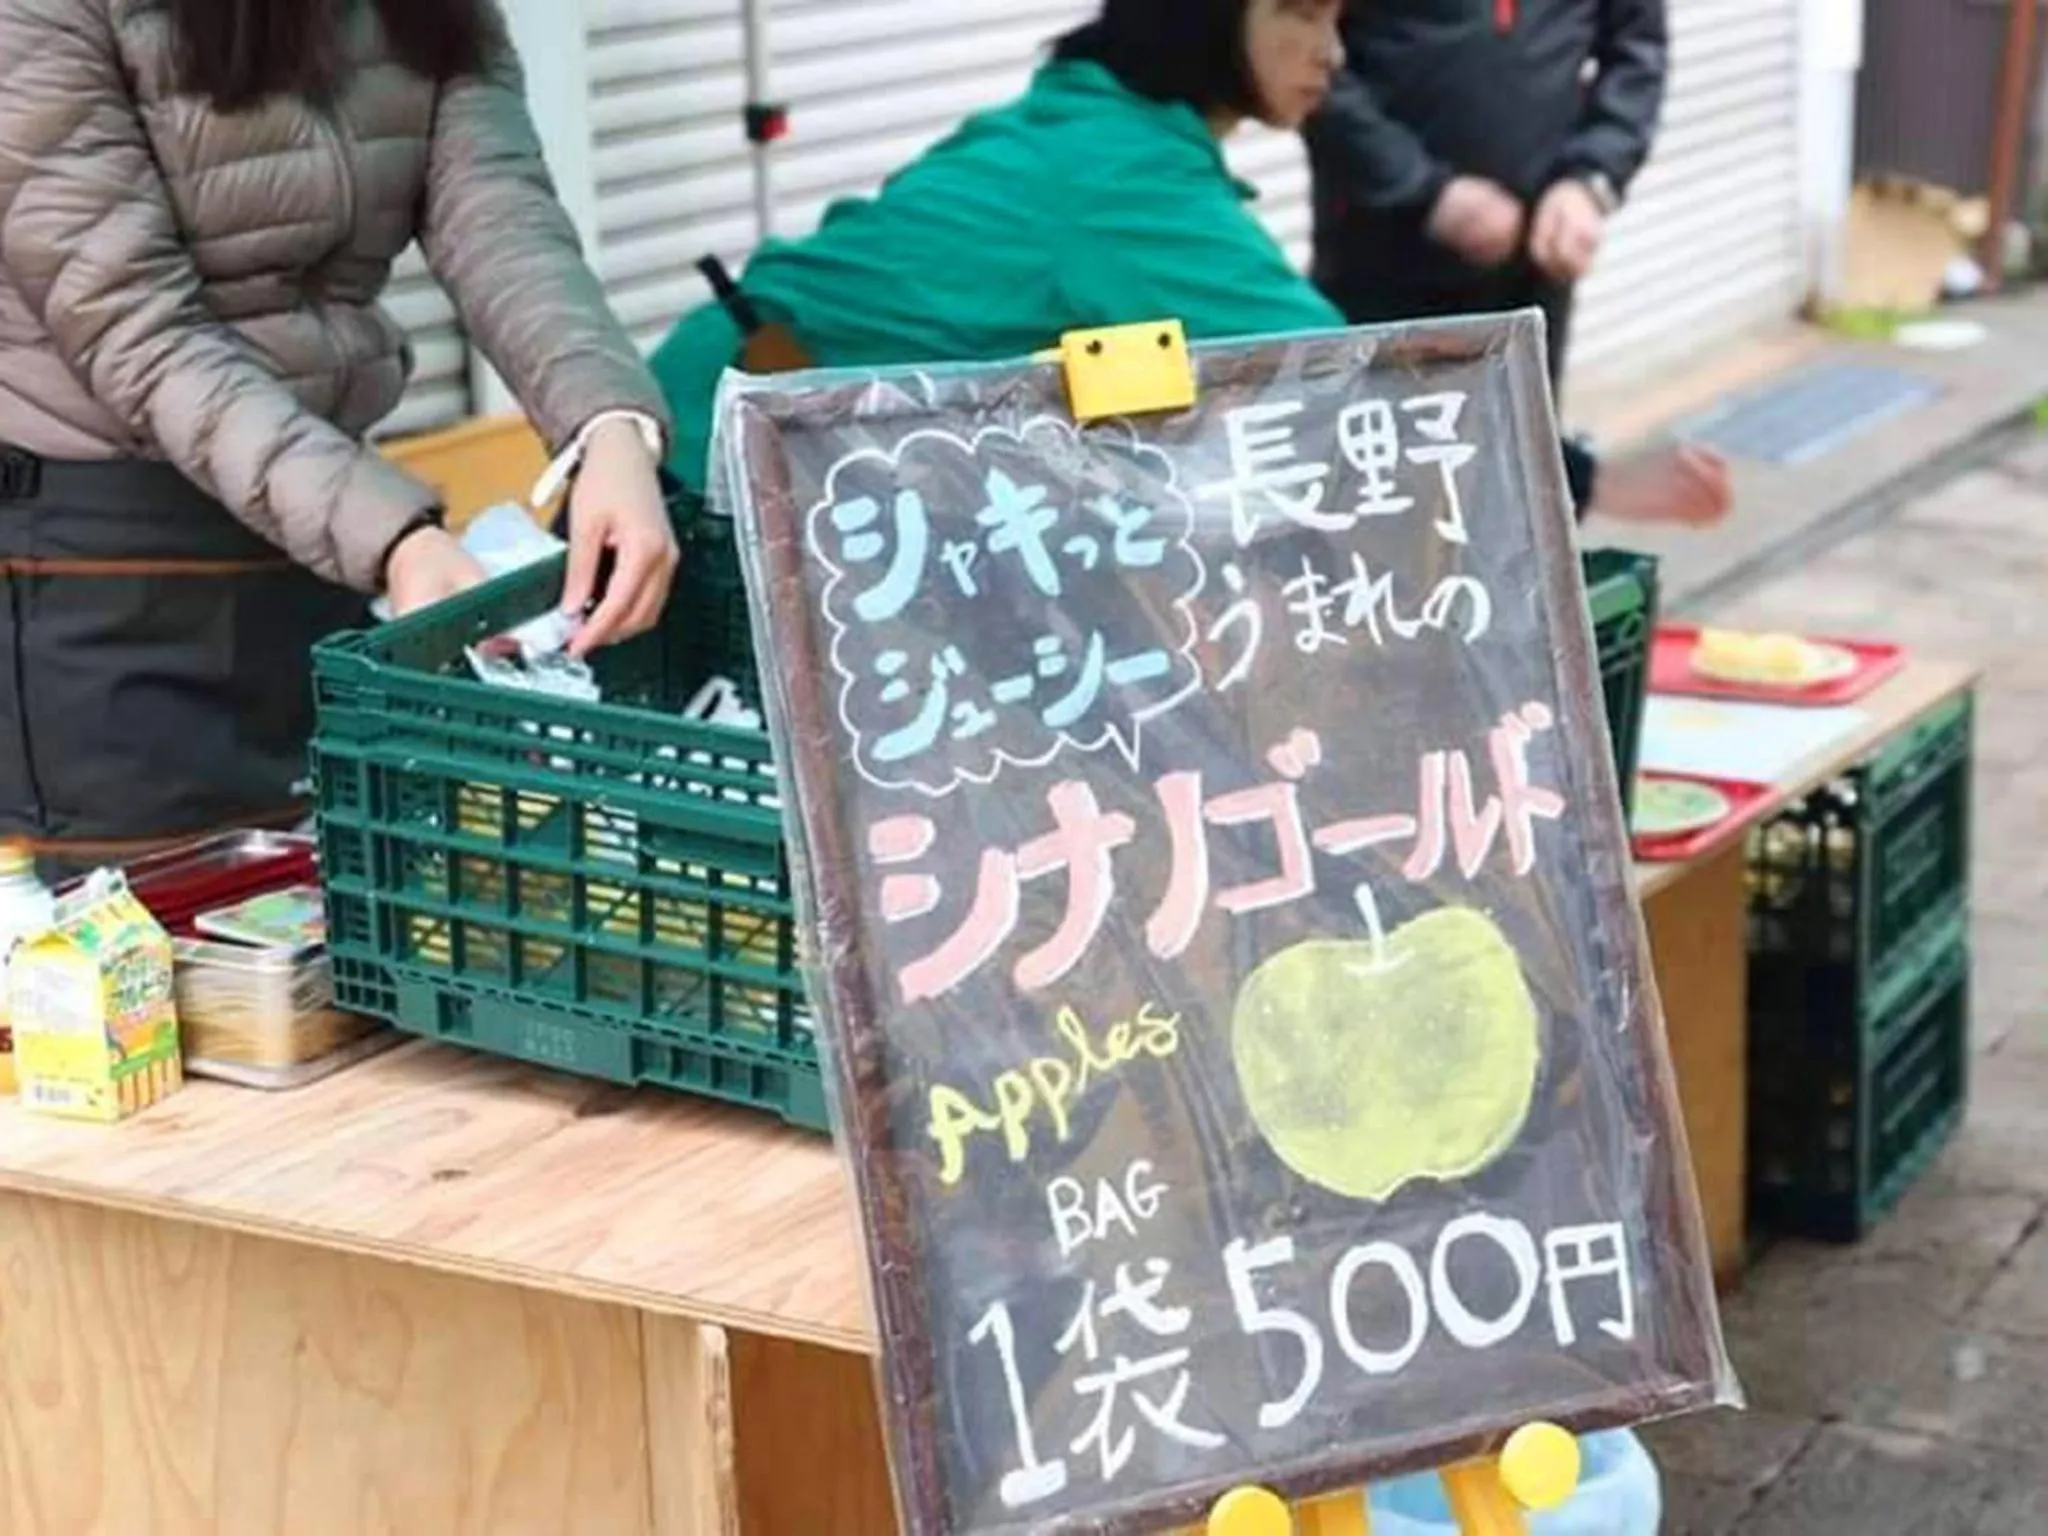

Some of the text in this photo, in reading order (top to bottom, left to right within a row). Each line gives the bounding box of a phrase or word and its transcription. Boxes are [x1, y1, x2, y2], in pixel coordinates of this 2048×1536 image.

[831, 467, 1167, 622] シャキっと
[1197, 391, 1478, 546] 長野
[871, 631, 1170, 760] ジューシー
[1208, 552, 1491, 691] うまれの
[868, 701, 1565, 1003] シナノゴールド
[928, 1002, 1181, 1183] Apples
[1046, 1161, 1168, 1255] BAG
